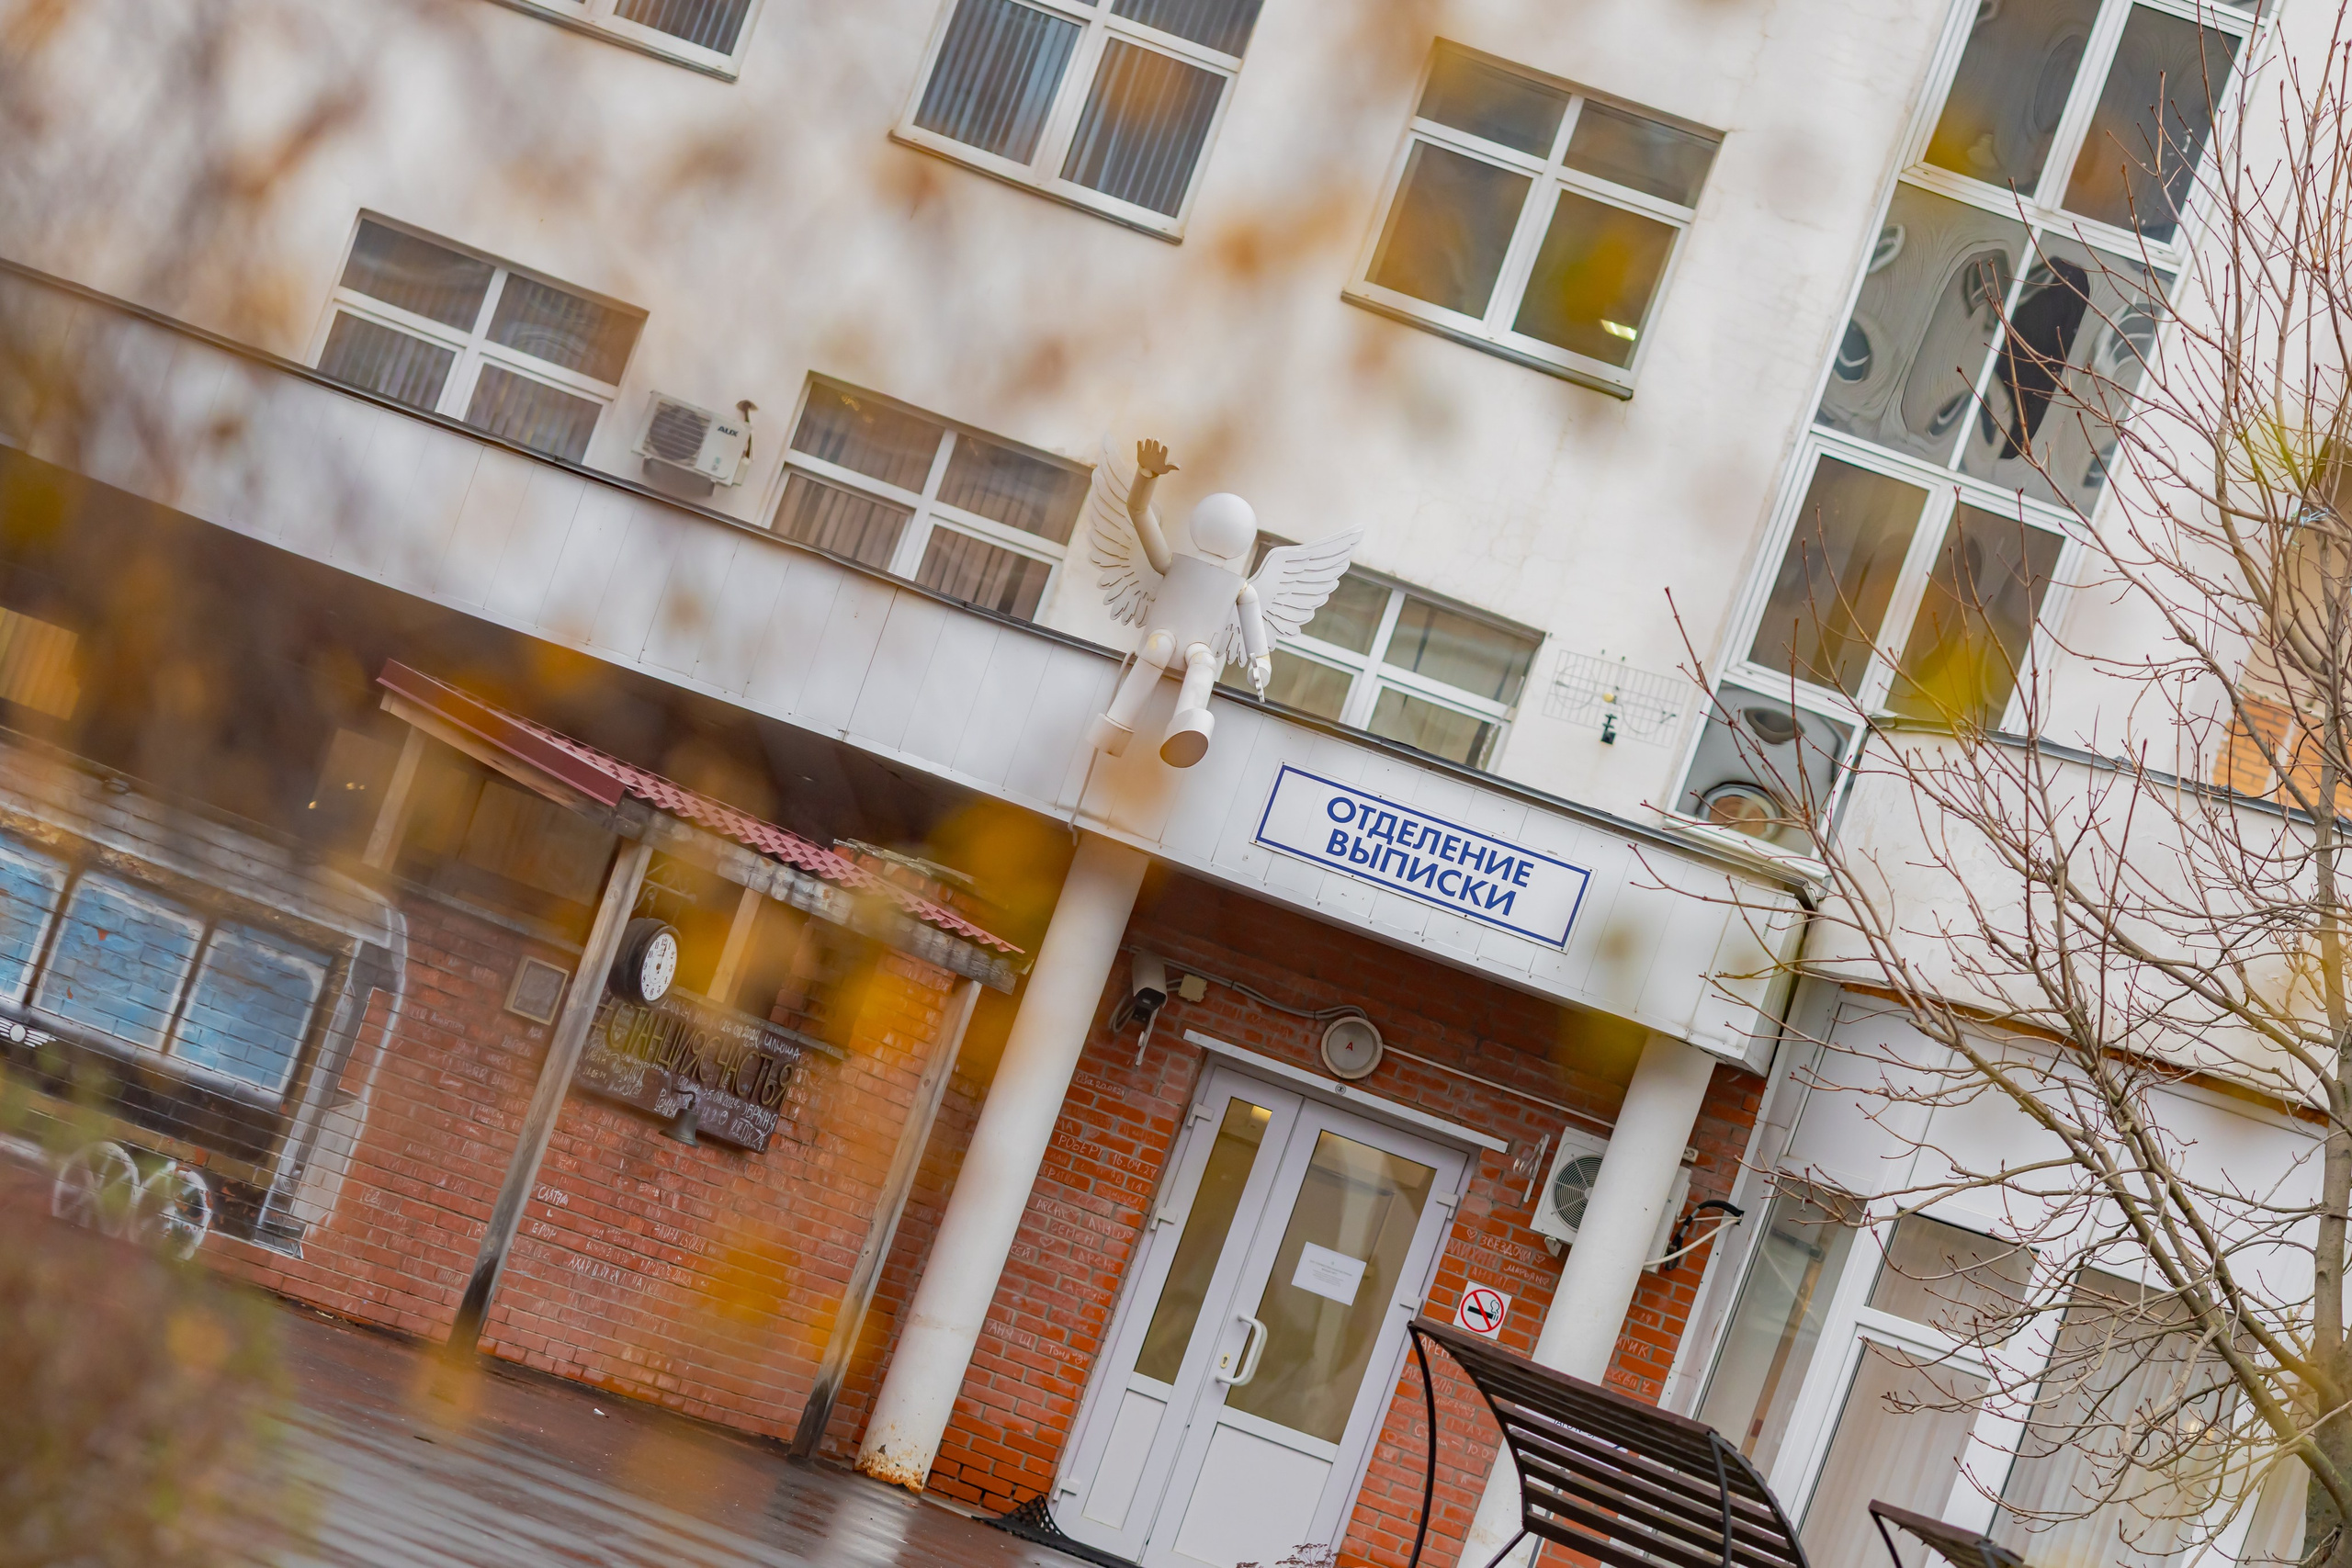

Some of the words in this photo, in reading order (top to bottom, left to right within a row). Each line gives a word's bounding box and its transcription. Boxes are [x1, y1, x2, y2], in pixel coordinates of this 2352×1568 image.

[717, 425, 739, 437] AUX
[1327, 796, 1534, 888] ОТДЕЛЕНИЕ
[1326, 829, 1517, 917] ВЫПИСКИ
[988, 1320, 1014, 1340] АНЯ
